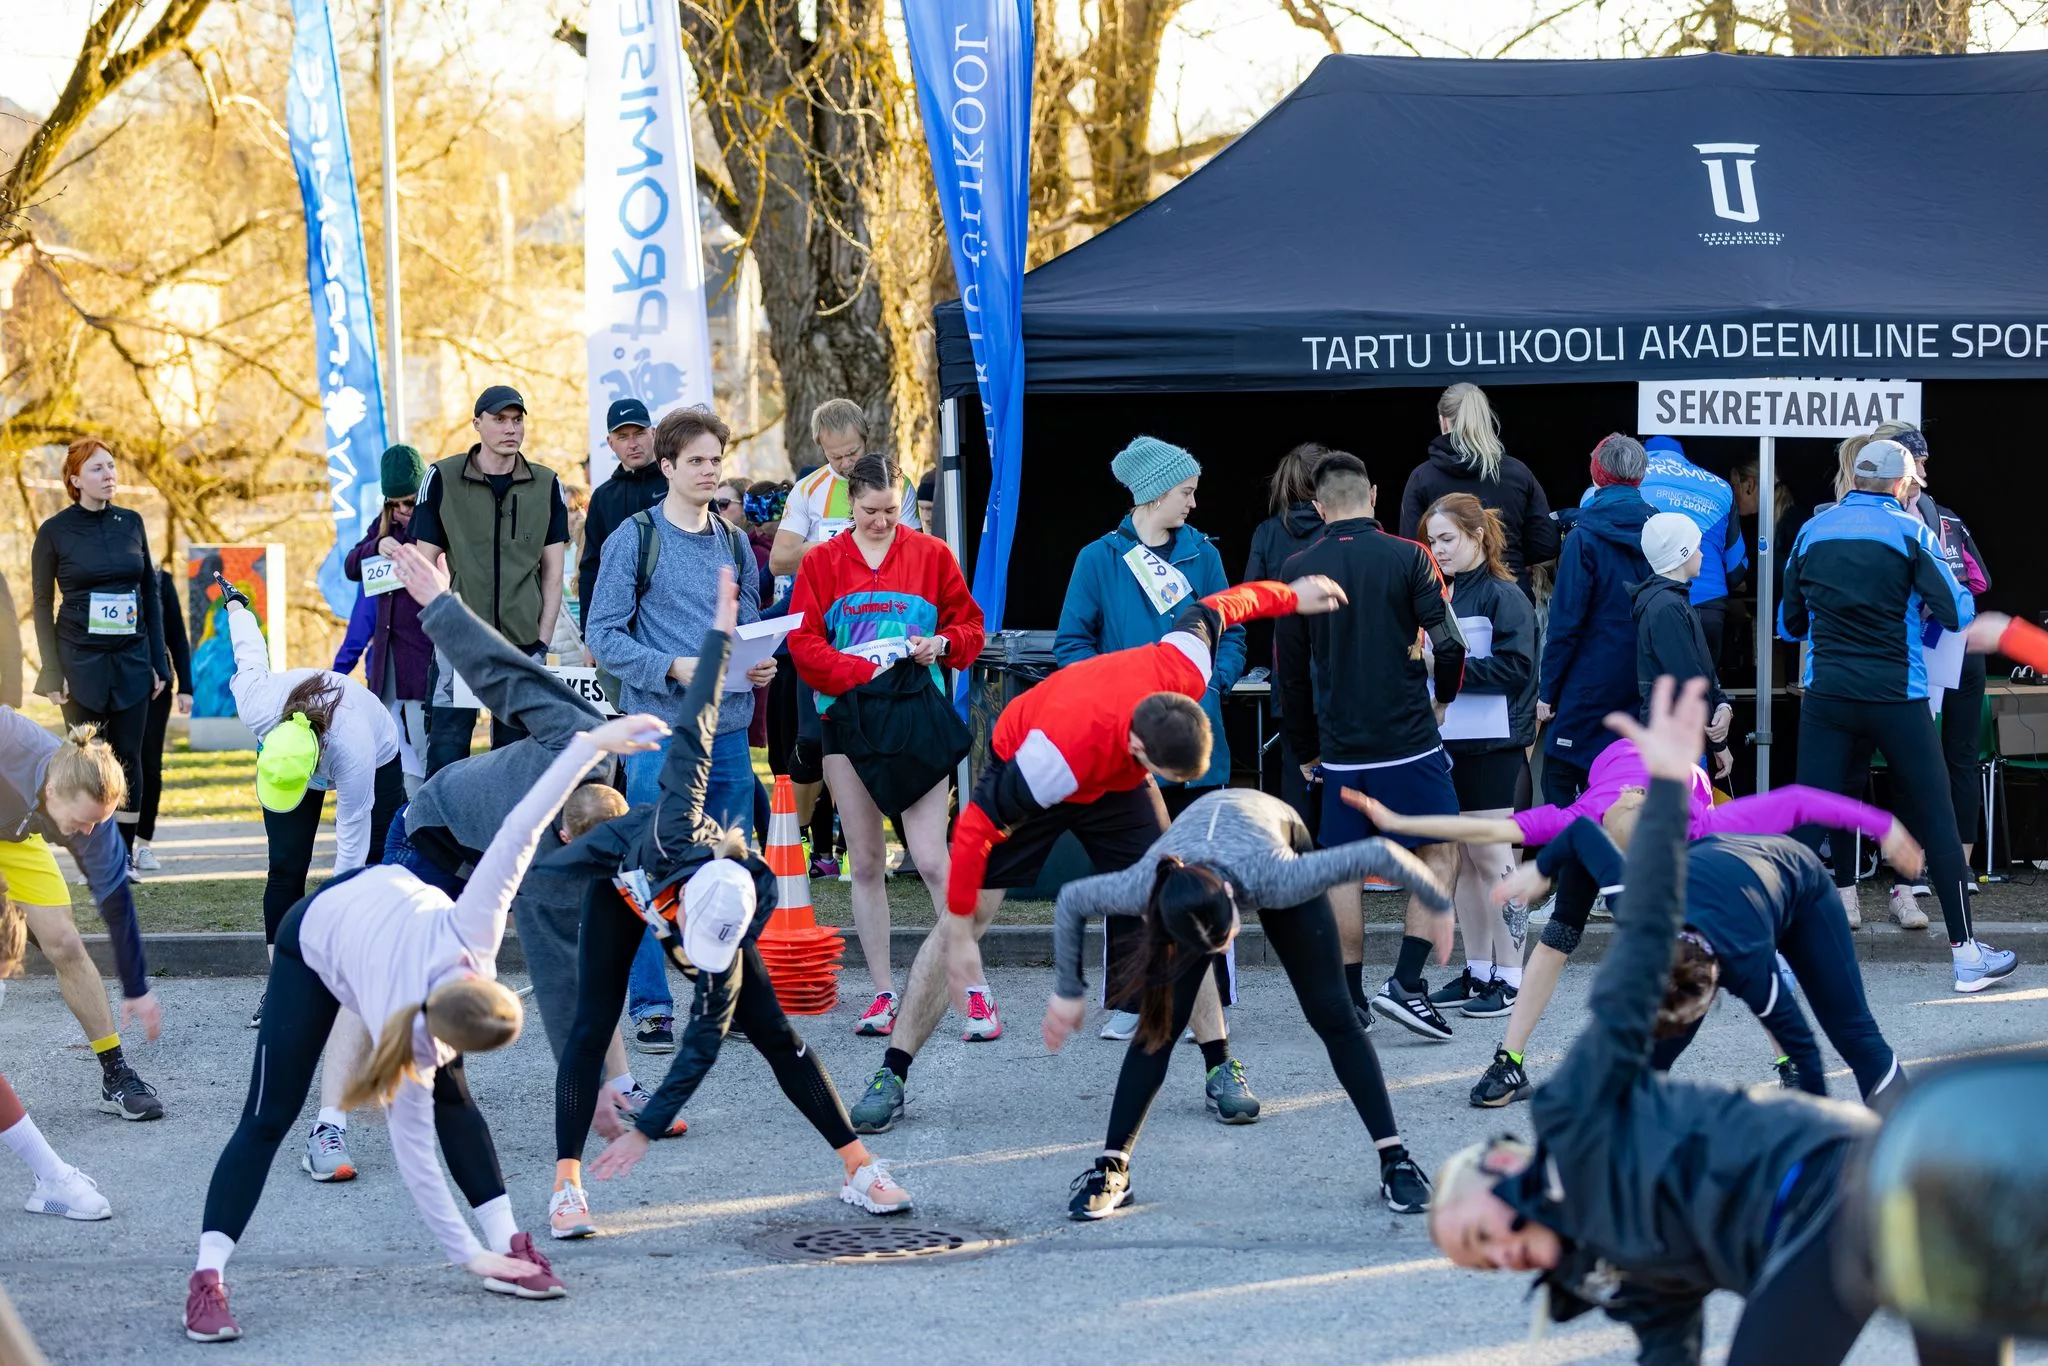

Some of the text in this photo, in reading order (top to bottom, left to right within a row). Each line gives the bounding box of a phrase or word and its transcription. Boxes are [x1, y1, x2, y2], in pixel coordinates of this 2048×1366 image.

[1302, 334, 1431, 370] TARTU
[1446, 323, 1625, 366] ÜLIKOOLI
[1639, 322, 1939, 360] AKADEEMILINE
[1656, 389, 1904, 427] SEKRETARIAAT
[1669, 498, 1713, 514] TO SPORT
[1143, 549, 1167, 576] 179
[367, 563, 392, 581] 267
[101, 605, 119, 619] 16
[842, 600, 893, 617] hummel
